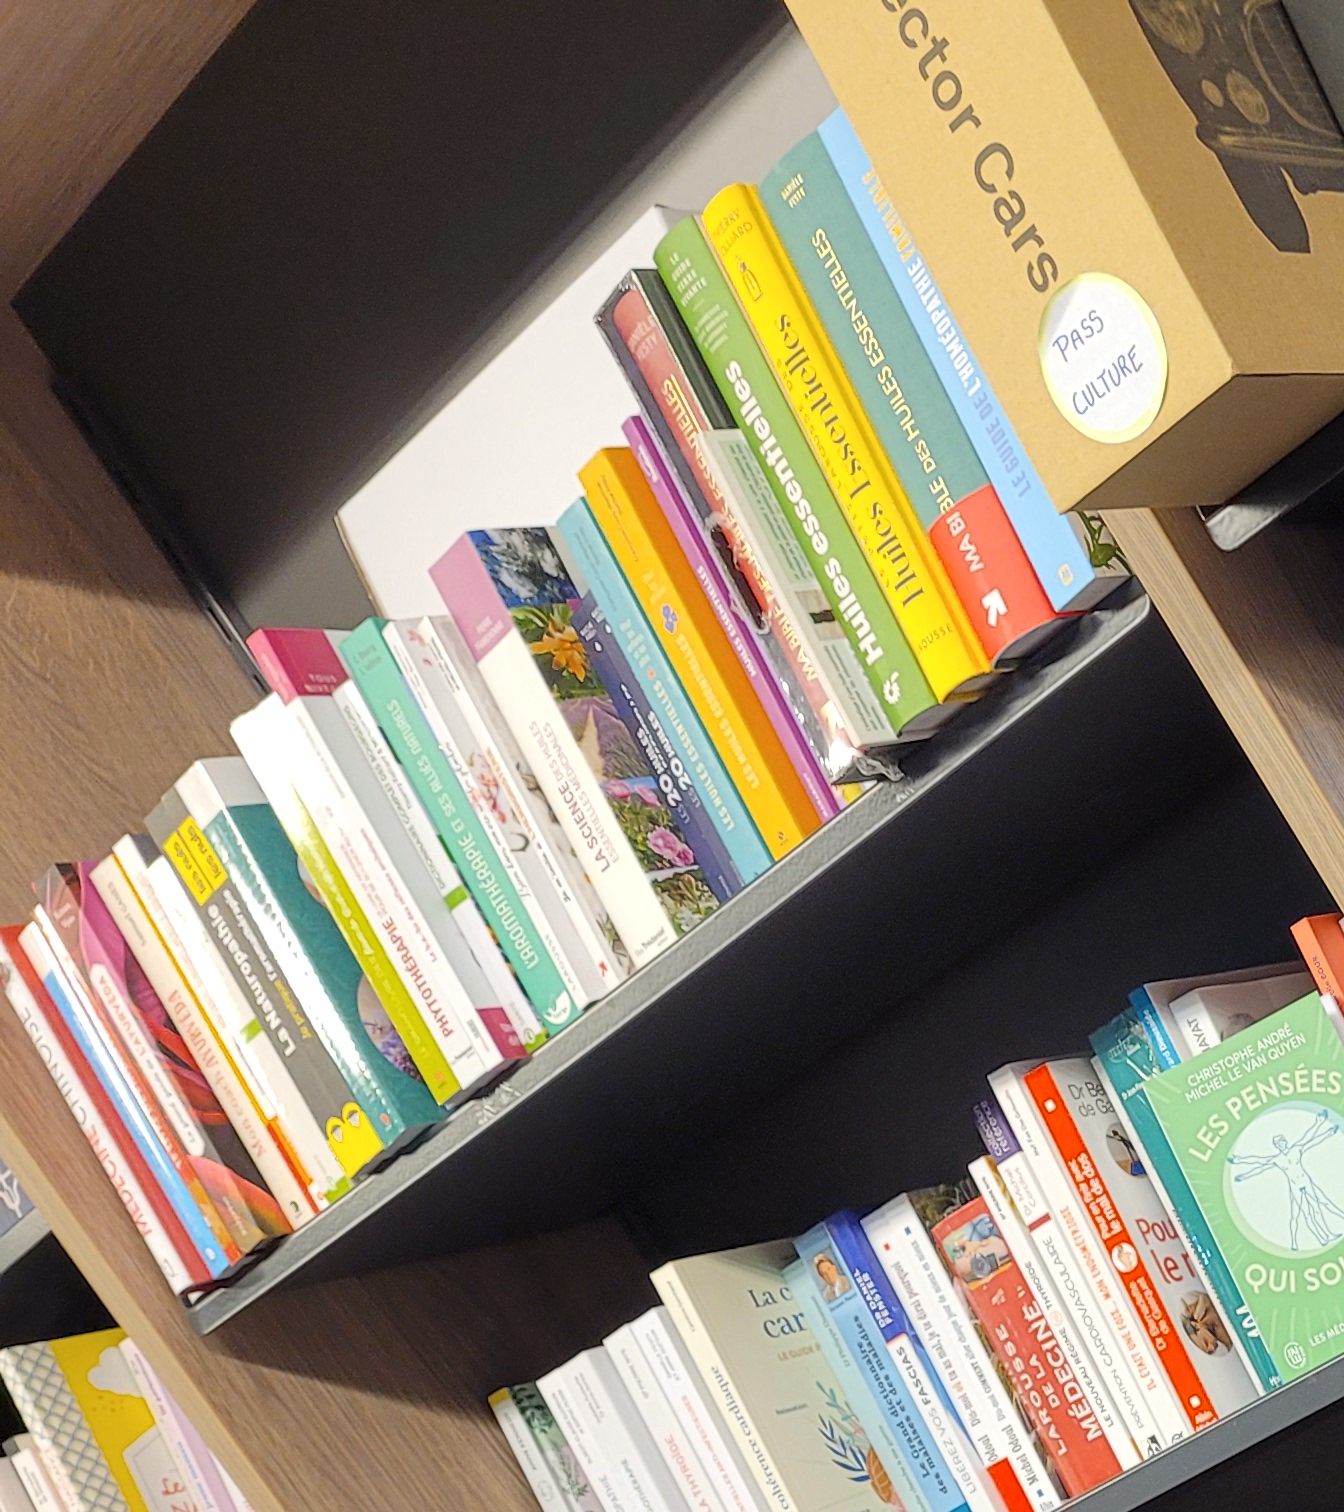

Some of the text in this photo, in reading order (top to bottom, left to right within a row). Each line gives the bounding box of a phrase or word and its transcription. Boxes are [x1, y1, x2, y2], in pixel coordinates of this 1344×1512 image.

[974, 142, 1059, 293] Cars
[1052, 309, 1104, 363] PASS
[1072, 345, 1143, 416] CULTURE
[724, 360, 830, 556] essentielles
[776, 315, 925, 607] Huiles Essentielles
[824, 550, 884, 668] Huiles
[1188, 1063, 1342, 1163] LES PENSÉES
[1245, 1263, 1296, 1294] QUI
